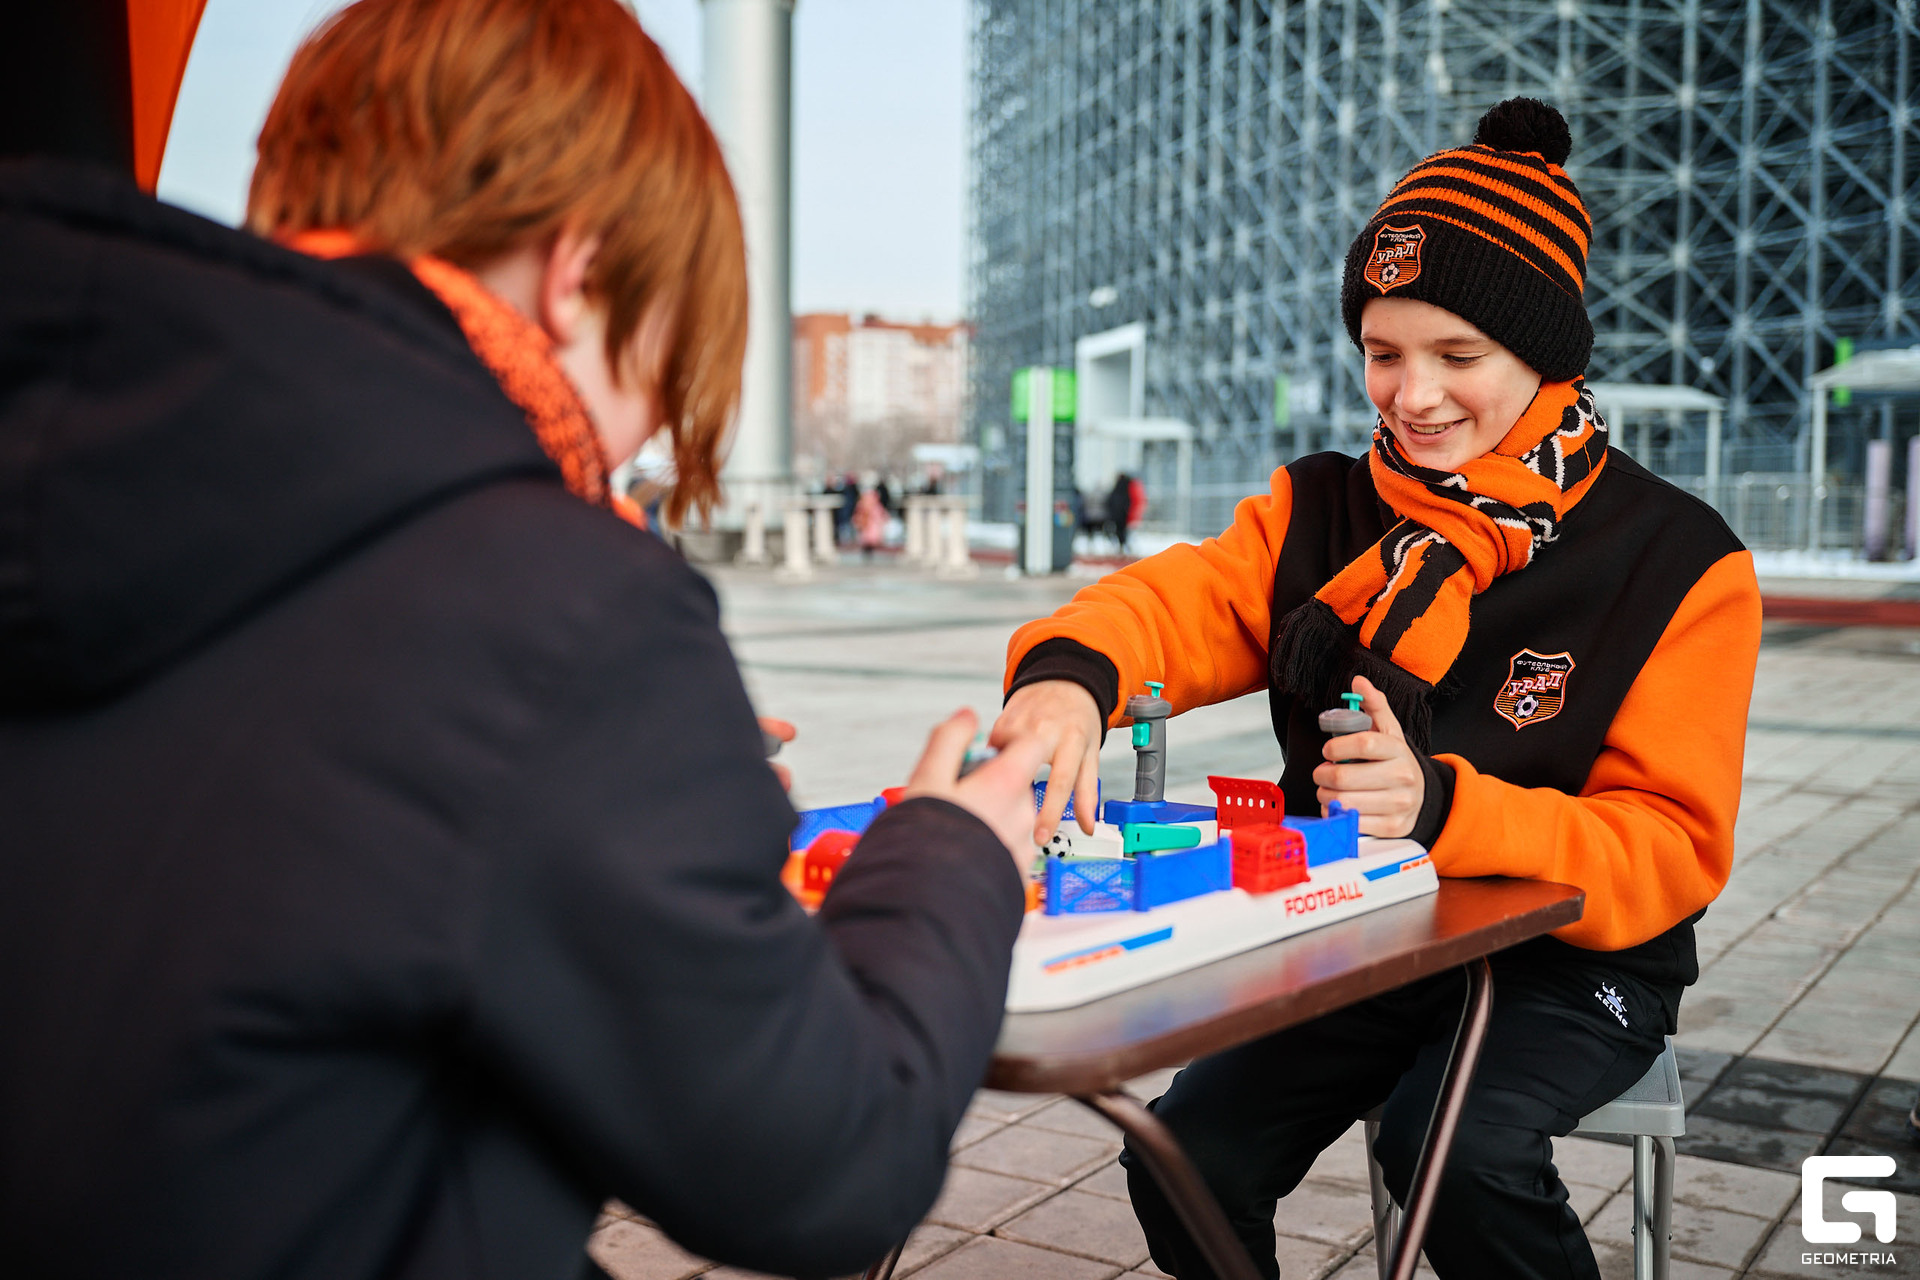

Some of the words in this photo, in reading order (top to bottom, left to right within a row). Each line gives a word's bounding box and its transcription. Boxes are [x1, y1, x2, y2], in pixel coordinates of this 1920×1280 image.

[1377, 243, 1416, 264] УРАЛ
[1508, 672, 1563, 696] УРАЛ
[1284, 881, 1363, 918] FOOTBALL
[1594, 991, 1628, 1028] KELME
